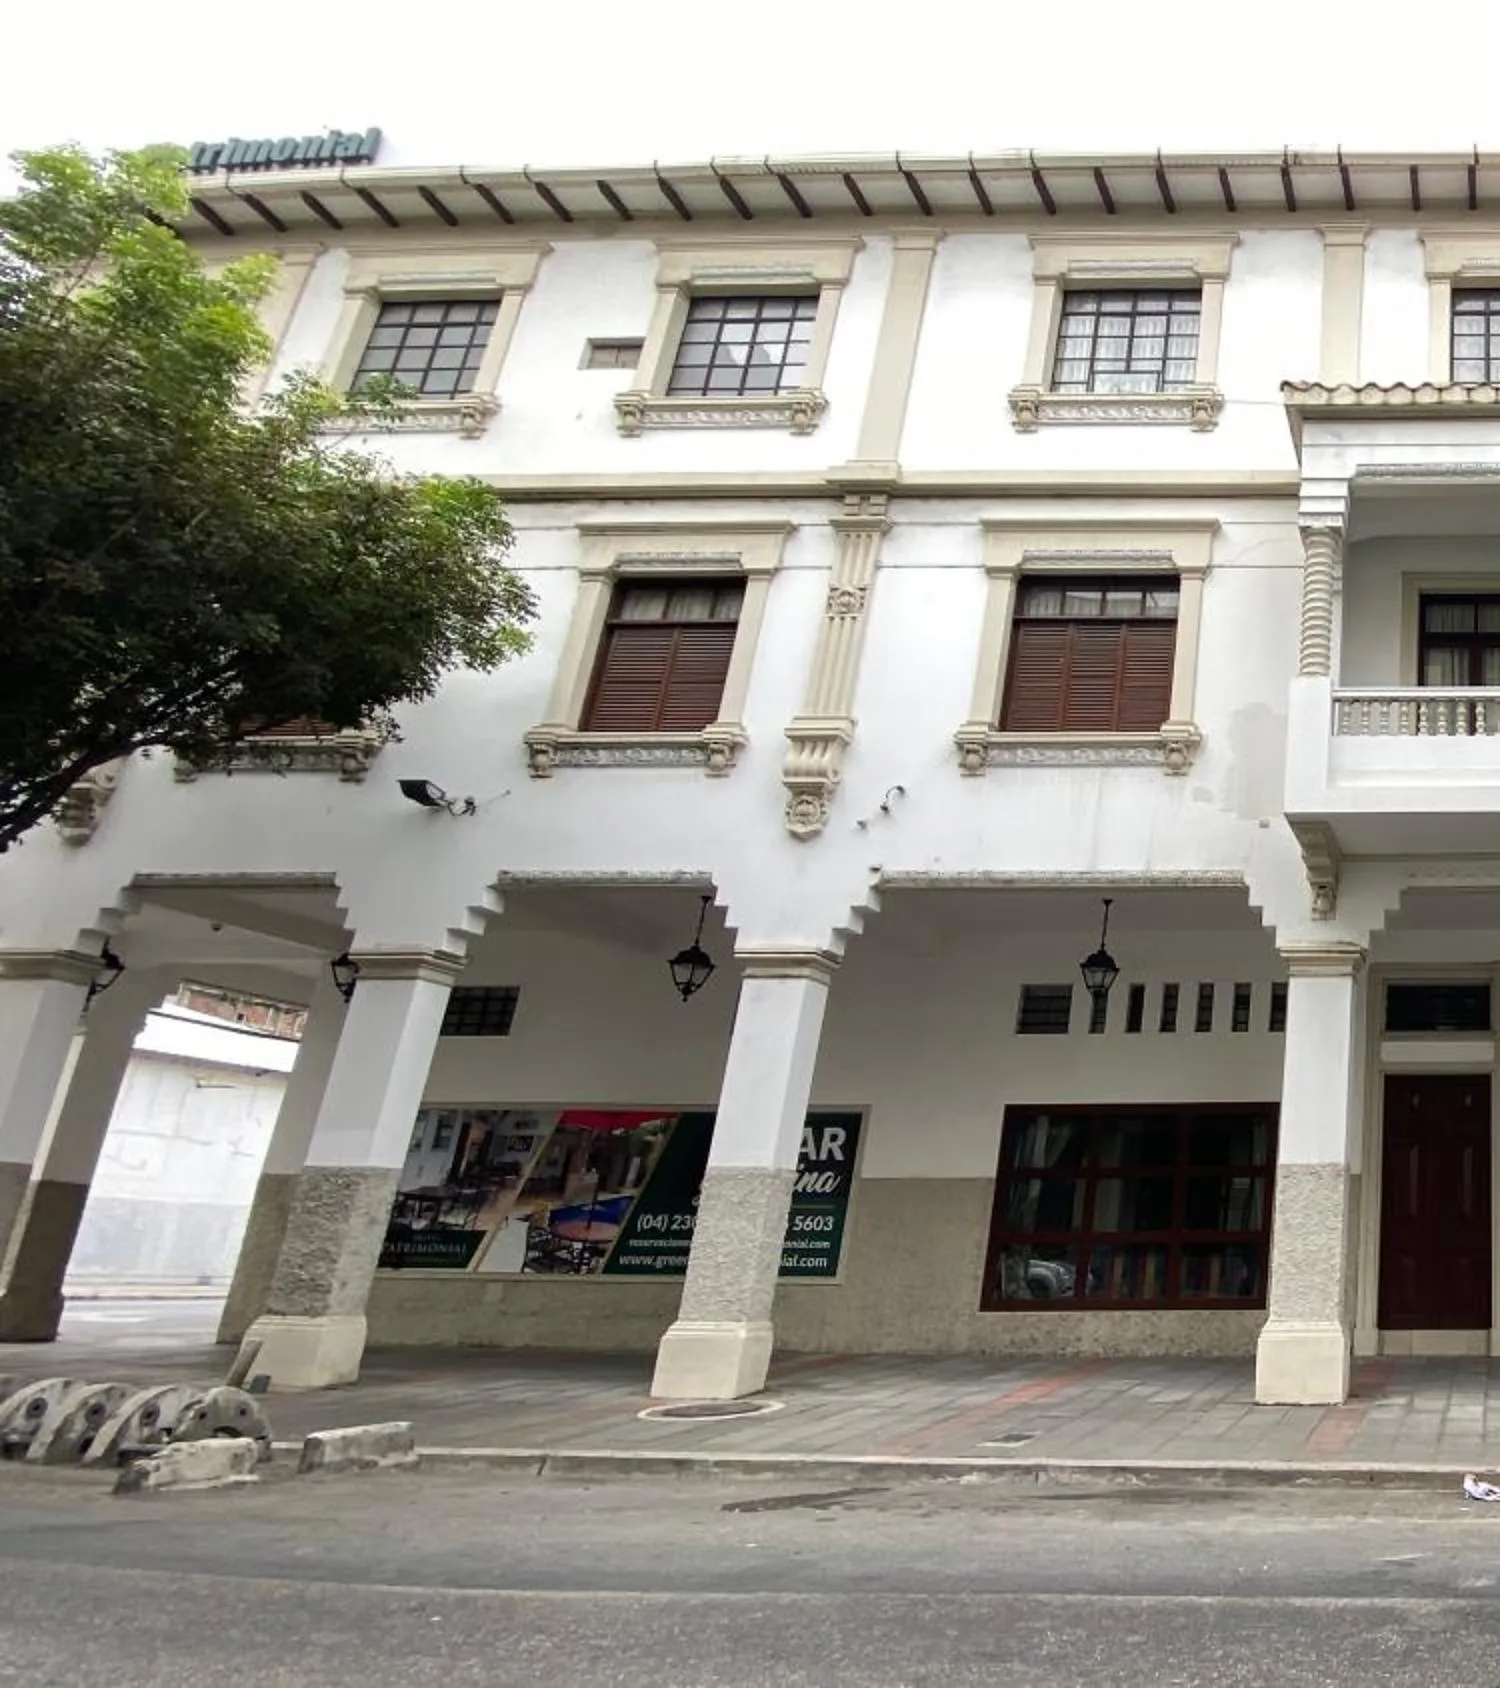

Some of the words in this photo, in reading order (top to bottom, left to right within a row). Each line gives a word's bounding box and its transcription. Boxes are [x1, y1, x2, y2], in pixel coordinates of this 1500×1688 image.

[189, 127, 382, 173] trimonial
[798, 1127, 845, 1161] AR
[794, 1163, 841, 1193] ina
[637, 1213, 669, 1233] (04)
[670, 1213, 697, 1231] 23
[792, 1215, 834, 1231] 5603
